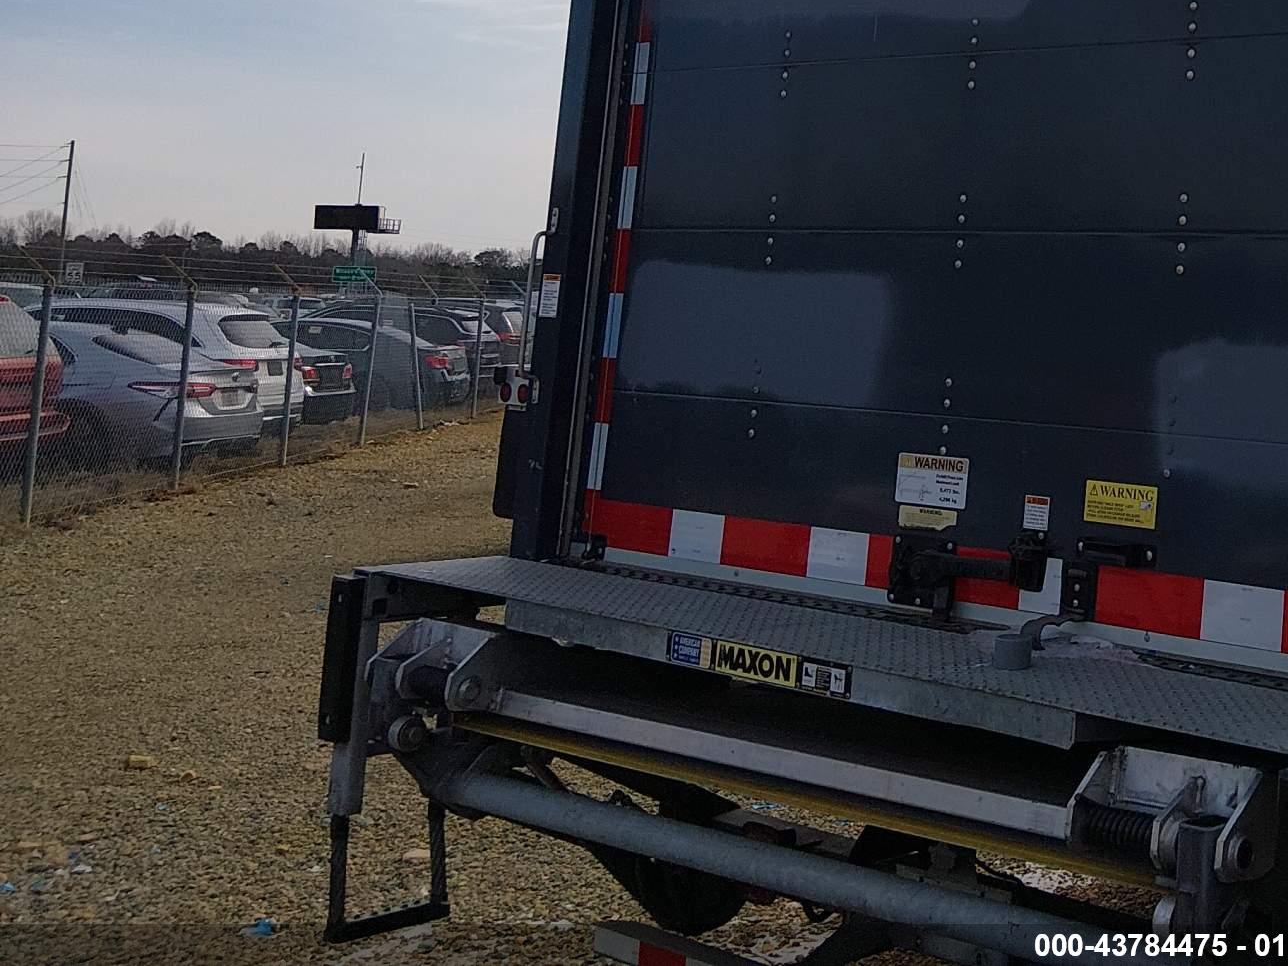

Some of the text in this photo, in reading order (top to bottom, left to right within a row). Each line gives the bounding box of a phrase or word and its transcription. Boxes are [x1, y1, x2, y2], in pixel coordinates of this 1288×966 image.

[914, 456, 964, 472] WARNING
[1100, 485, 1154, 501] WARNING
[717, 644, 792, 682] MAXON
